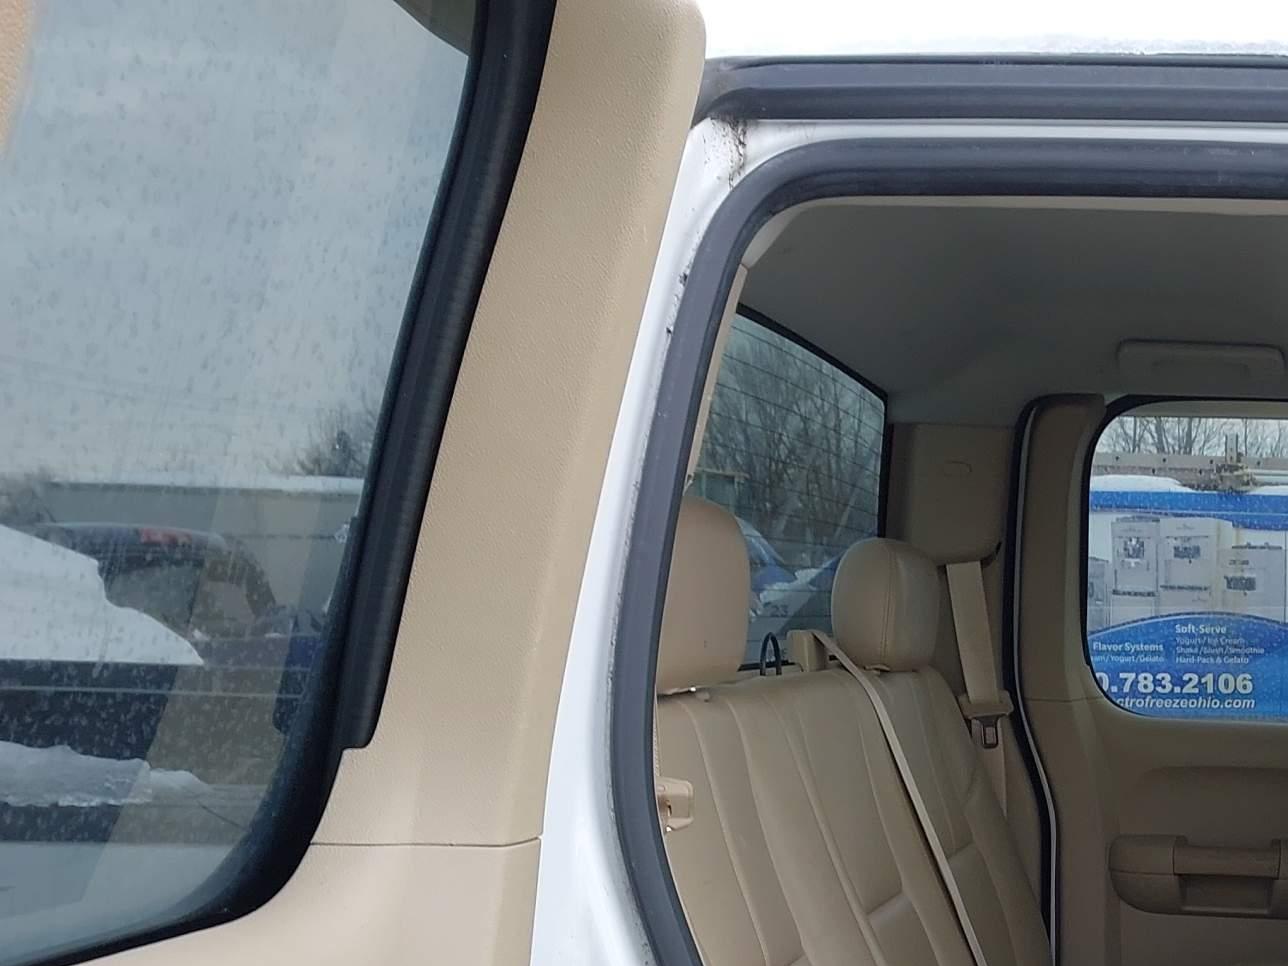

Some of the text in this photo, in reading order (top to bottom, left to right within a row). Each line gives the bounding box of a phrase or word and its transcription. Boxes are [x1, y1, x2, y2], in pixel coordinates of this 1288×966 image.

[1175, 623, 1227, 634] Soft-Serve
[1093, 641, 1163, 652] Flavor Systems
[1223, 655, 1249, 664] Gelato
